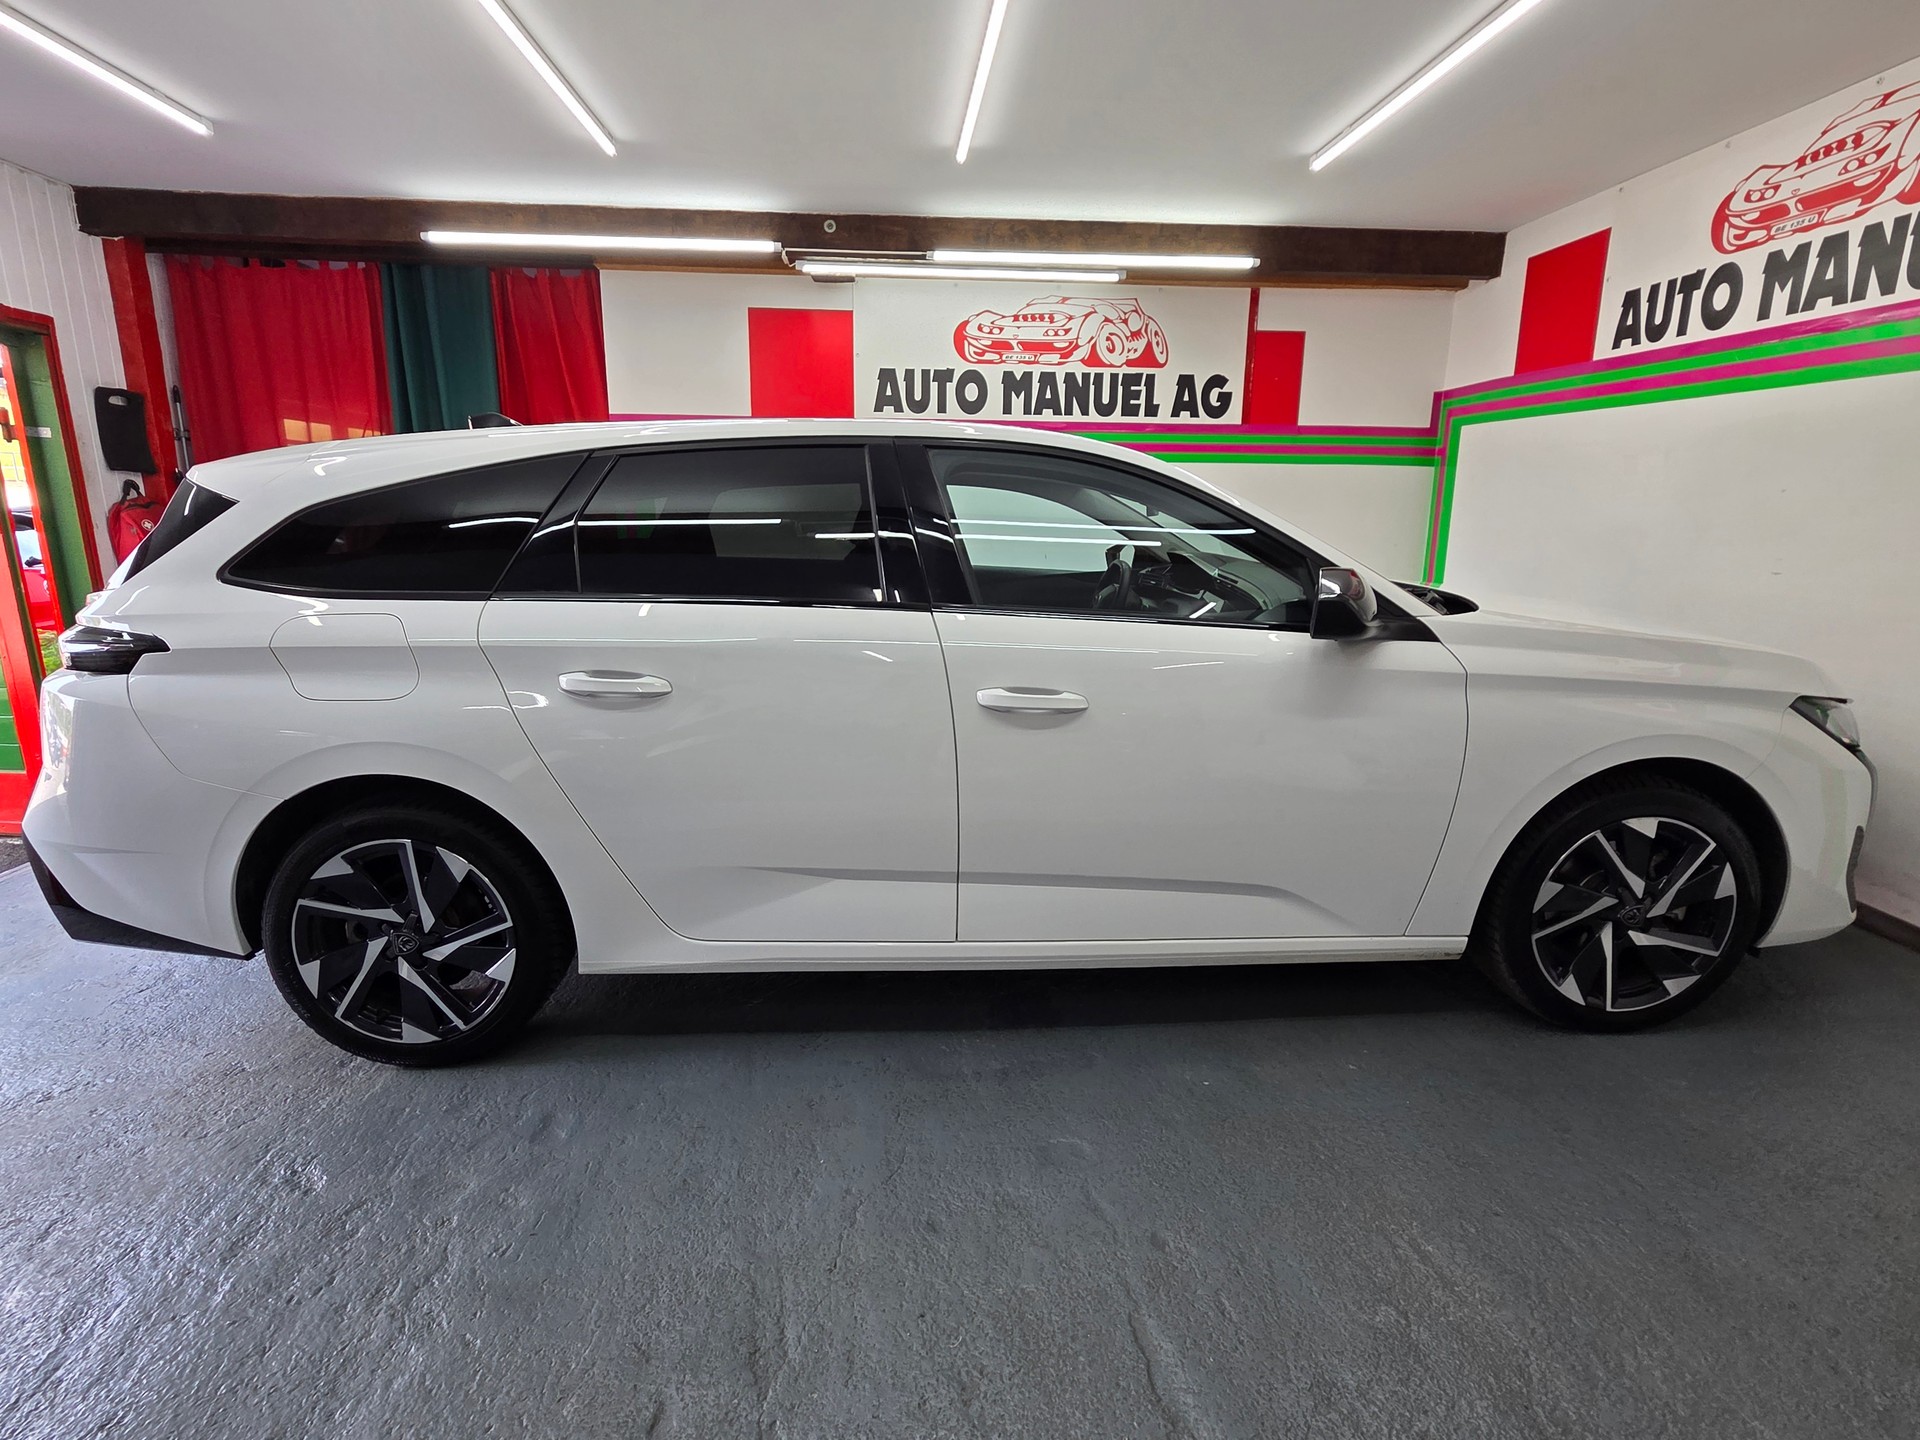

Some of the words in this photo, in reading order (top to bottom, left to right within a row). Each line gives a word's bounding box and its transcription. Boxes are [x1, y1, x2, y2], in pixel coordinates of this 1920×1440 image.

[1611, 261, 1744, 350] AUTO
[1756, 211, 1920, 322] MAN
[873, 367, 988, 415] AUTO
[1001, 370, 1161, 419] MANUEL
[1170, 374, 1233, 420] AG
